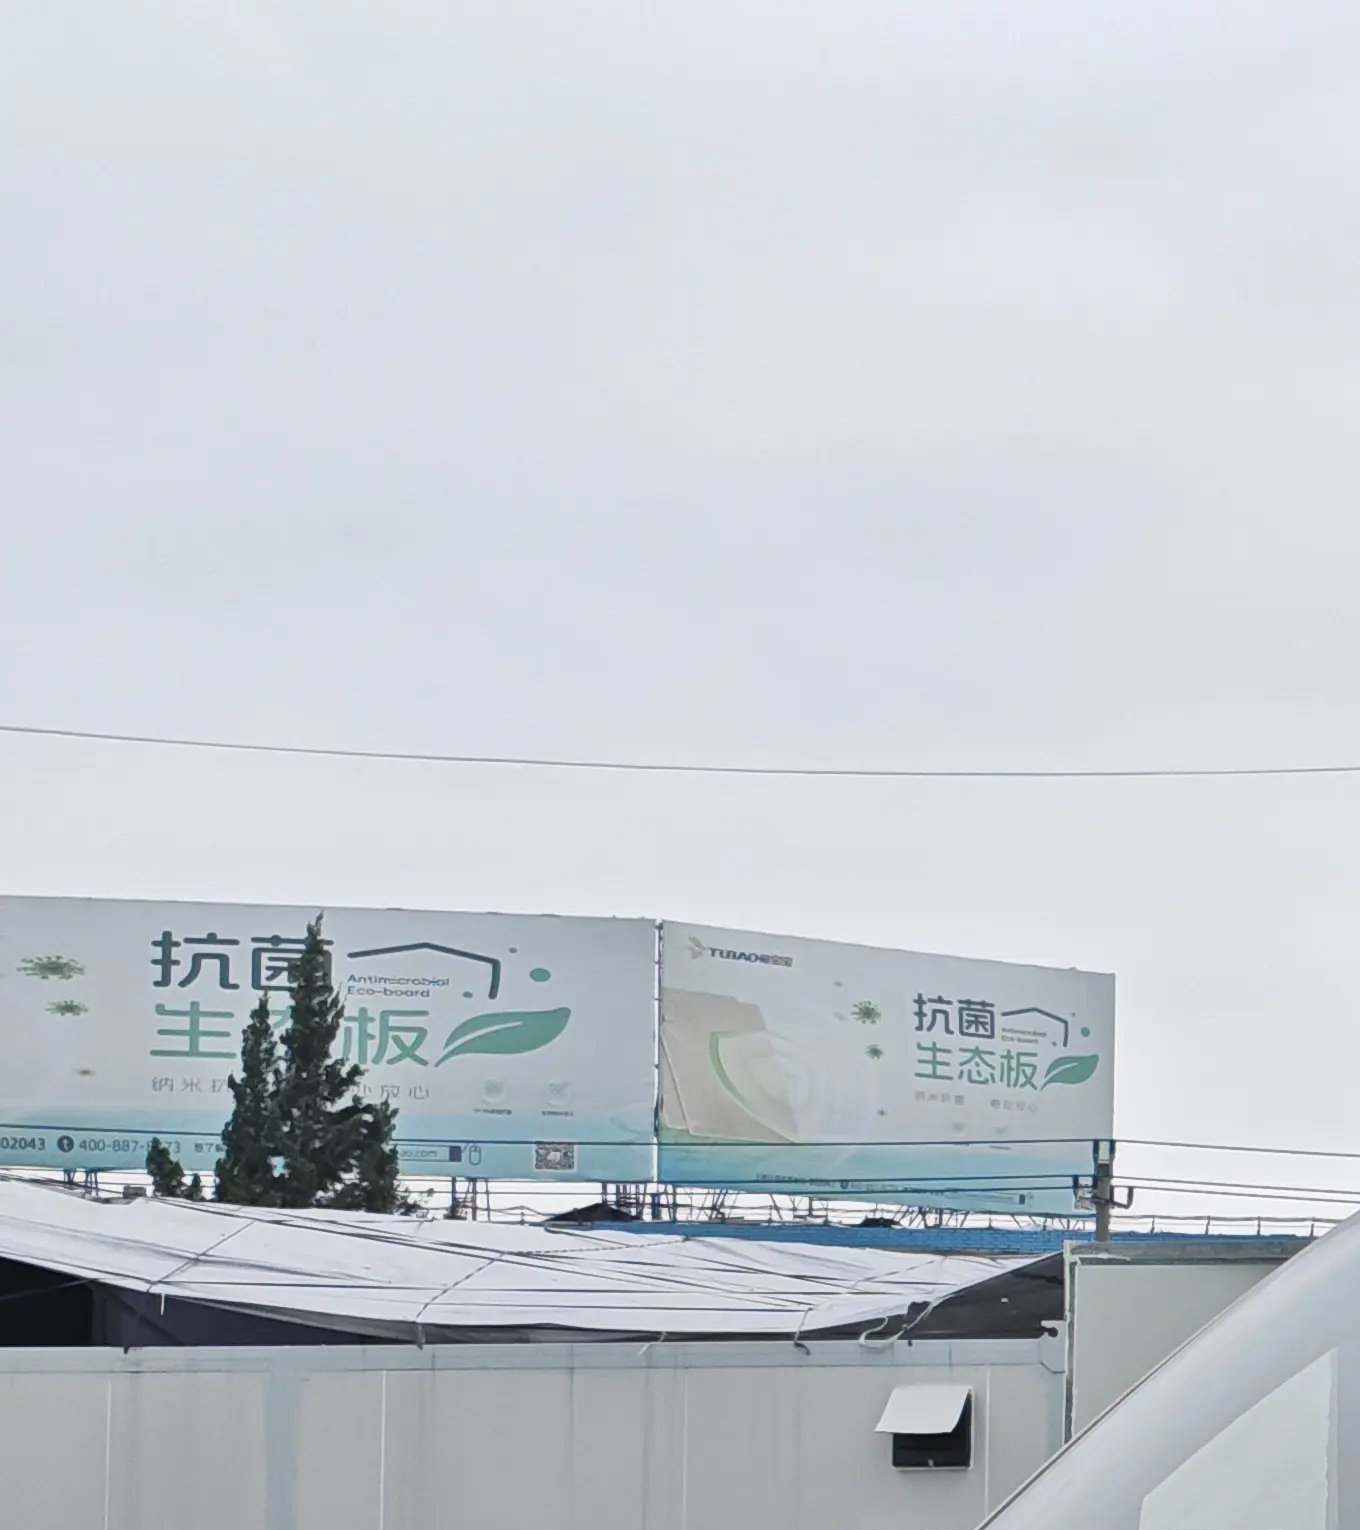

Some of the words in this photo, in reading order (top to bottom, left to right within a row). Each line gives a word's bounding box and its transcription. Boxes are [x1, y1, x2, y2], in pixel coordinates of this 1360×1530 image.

[151, 930, 334, 992] 抗菌
[347, 986, 430, 998] Eco-board
[149, 1001, 430, 1067] 生板
[912, 993, 995, 1040] 抗菌
[914, 1041, 1039, 1091] 生态板
[79, 1138, 181, 1154] 400-887-73
